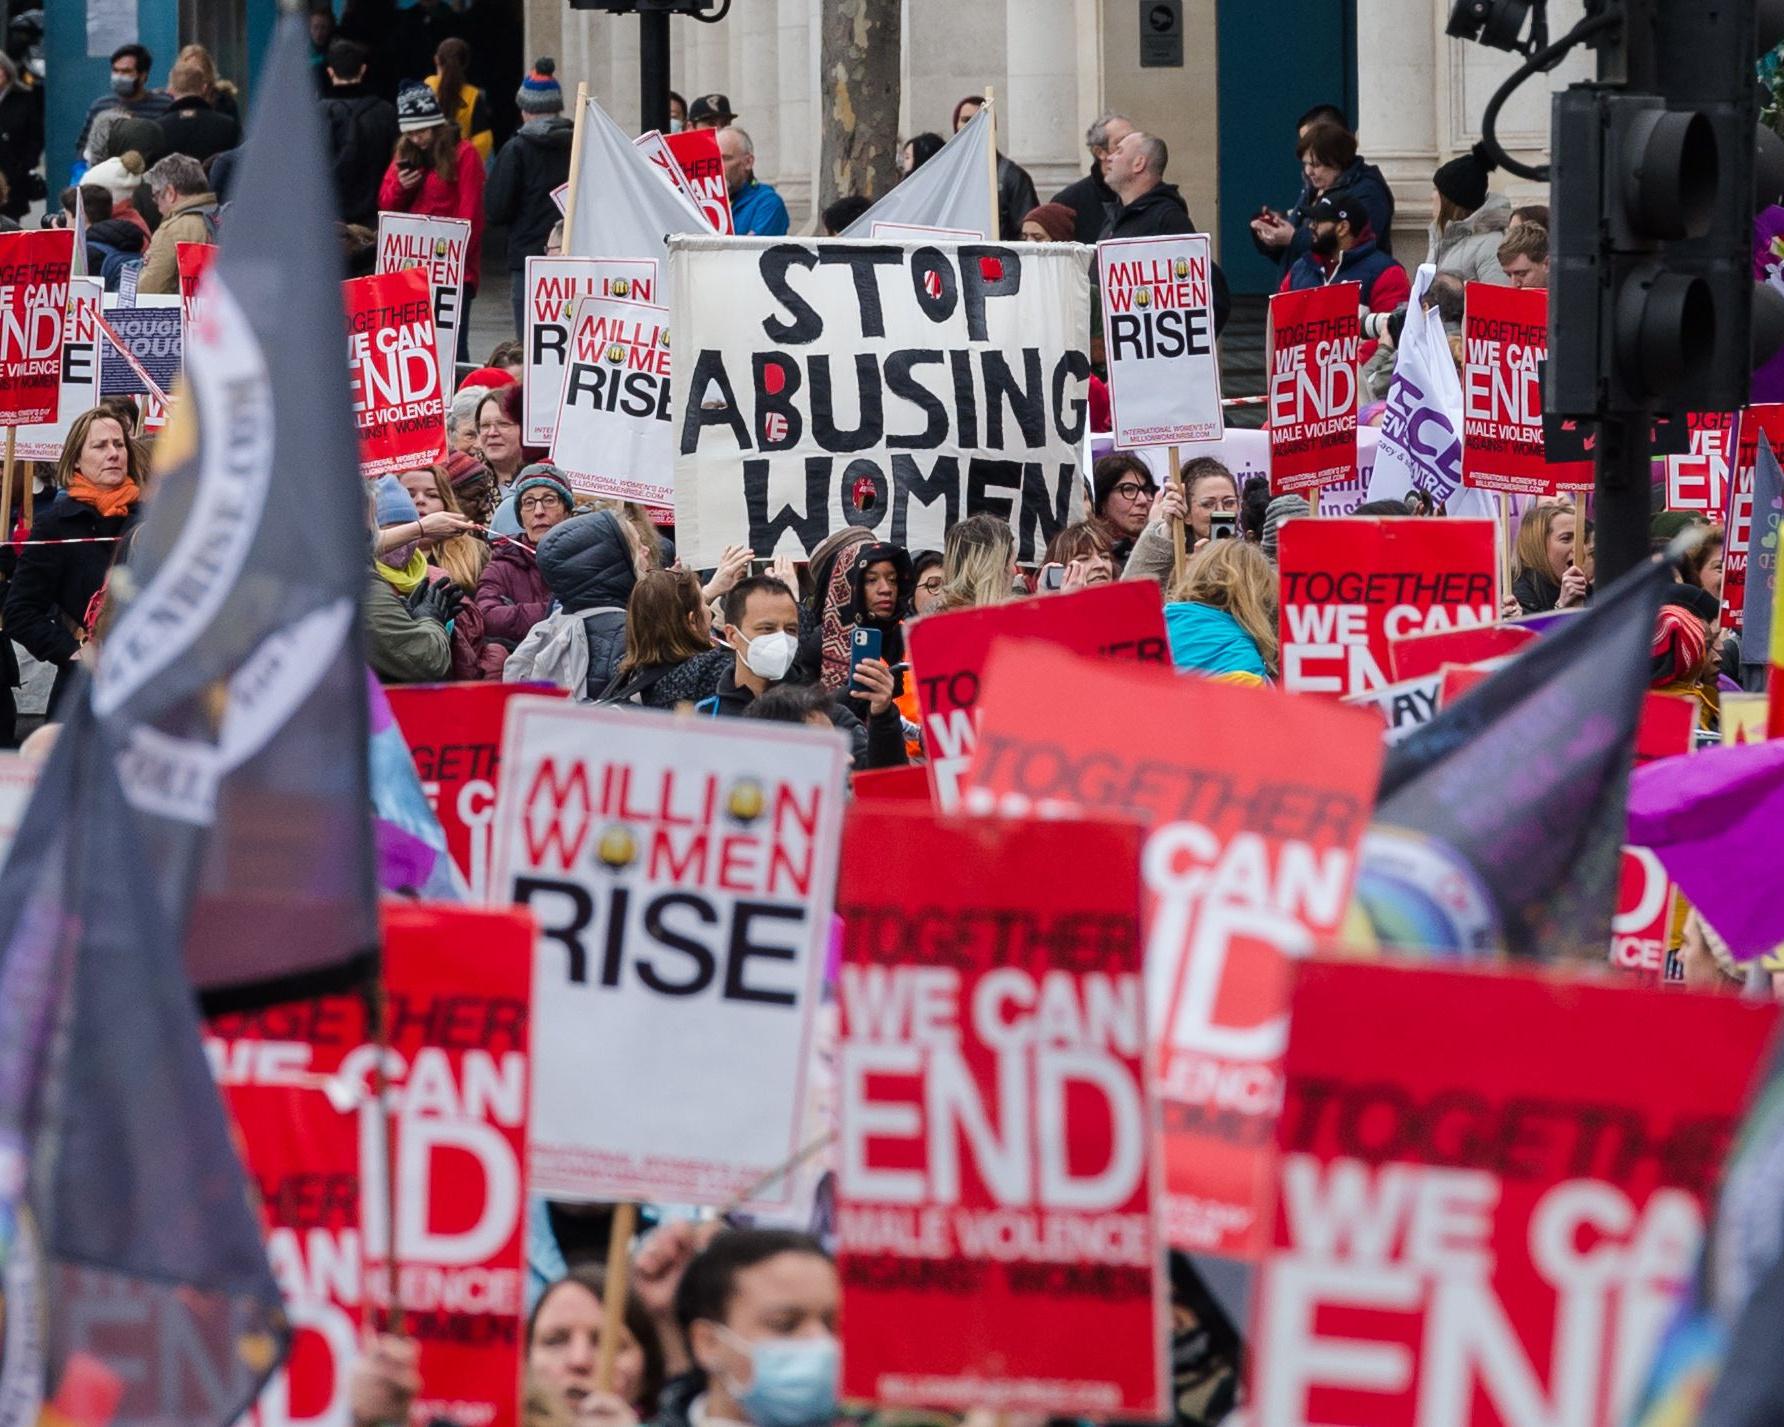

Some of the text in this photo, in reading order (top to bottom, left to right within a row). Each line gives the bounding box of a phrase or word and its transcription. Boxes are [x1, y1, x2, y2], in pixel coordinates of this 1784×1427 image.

[689, 174, 724, 201] AN
[384, 233, 462, 262] MILLION
[0, 262, 69, 283] GETHER
[1108, 256, 1206, 288] MILLION
[0, 286, 14, 310] E
[24, 283, 67, 310] CAN
[759, 244, 1021, 345] STOP
[1107, 282, 1207, 313] WOMEN
[0, 306, 61, 361] ND
[110, 319, 181, 338] NOUGH
[348, 301, 430, 333] GETHER
[376, 320, 434, 352] CAN
[1110, 309, 1211, 362] RISE
[1275, 315, 1358, 347] TOGETHER
[7, 360, 60, 378] VILENCE
[576, 338, 671, 377] WOME
[1275, 336, 1358, 374] WE CAN
[1467, 337, 1501, 368] WE
[356, 400, 443, 429] LE VIOLENCE
[680, 347, 1091, 456] ABUSING
[1270, 362, 1356, 428] END
[1272, 425, 1303, 445] MALE
[1304, 414, 1357, 438] VIOLENCE
[1465, 420, 1545, 444] MALE VIOLENC
[566, 469, 617, 485] TERNATIONAL
[567, 477, 665, 501] ILLIONWOMENRISE.COM
[1668, 453, 1731, 509] EN
[743, 454, 1075, 563] WOMEN
[1727, 555, 1748, 570] MA
[1284, 572, 1492, 605] TOGETHER
[1285, 603, 1369, 646] WE
[525, 755, 823, 839] MILLION
[976, 732, 1358, 845] TOGETHER
[523, 811, 812, 898] WOMEN
[1142, 821, 1350, 926] CAN
[513, 876, 807, 1008] RISE
[845, 905, 1137, 974] TOGETHER
[843, 964, 962, 1048] WE
[971, 966, 1141, 1054] CAN
[336, 1044, 526, 1129] CAN
[842, 1044, 1148, 1210] END
[841, 1205, 951, 1255] MALE
[954, 1211, 1152, 1267] VIOLENCE
[1283, 1153, 1502, 1268] WE
[1528, 1178, 1704, 1284] CA
[1256, 1254, 1672, 1427] EN
